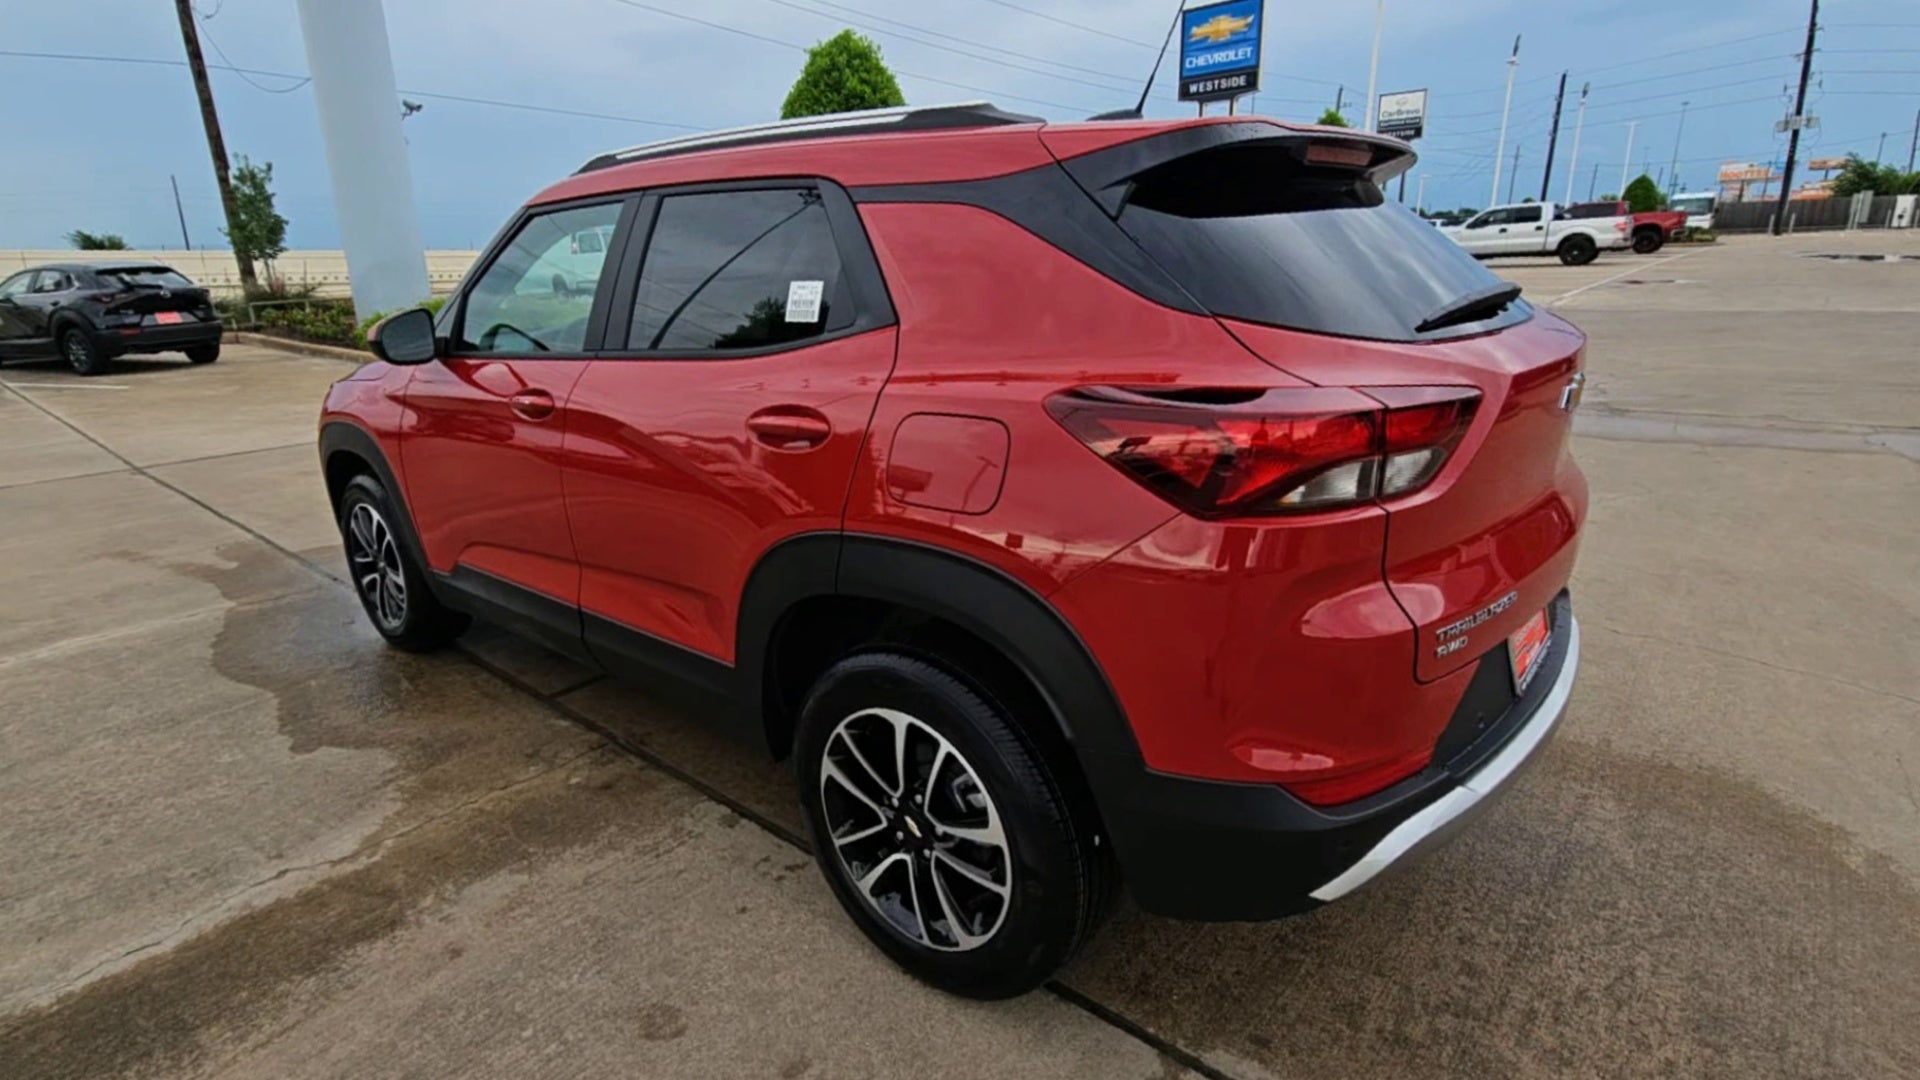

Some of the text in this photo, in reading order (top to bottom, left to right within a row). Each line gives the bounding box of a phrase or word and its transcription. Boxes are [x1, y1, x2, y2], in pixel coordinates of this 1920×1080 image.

[1185, 46, 1253, 68] CHEVROLET
[1189, 75, 1247, 94] WESTSIDE
[1381, 108, 1421, 118] CarBravo
[1435, 590, 1518, 642] TRAILBLAZER
